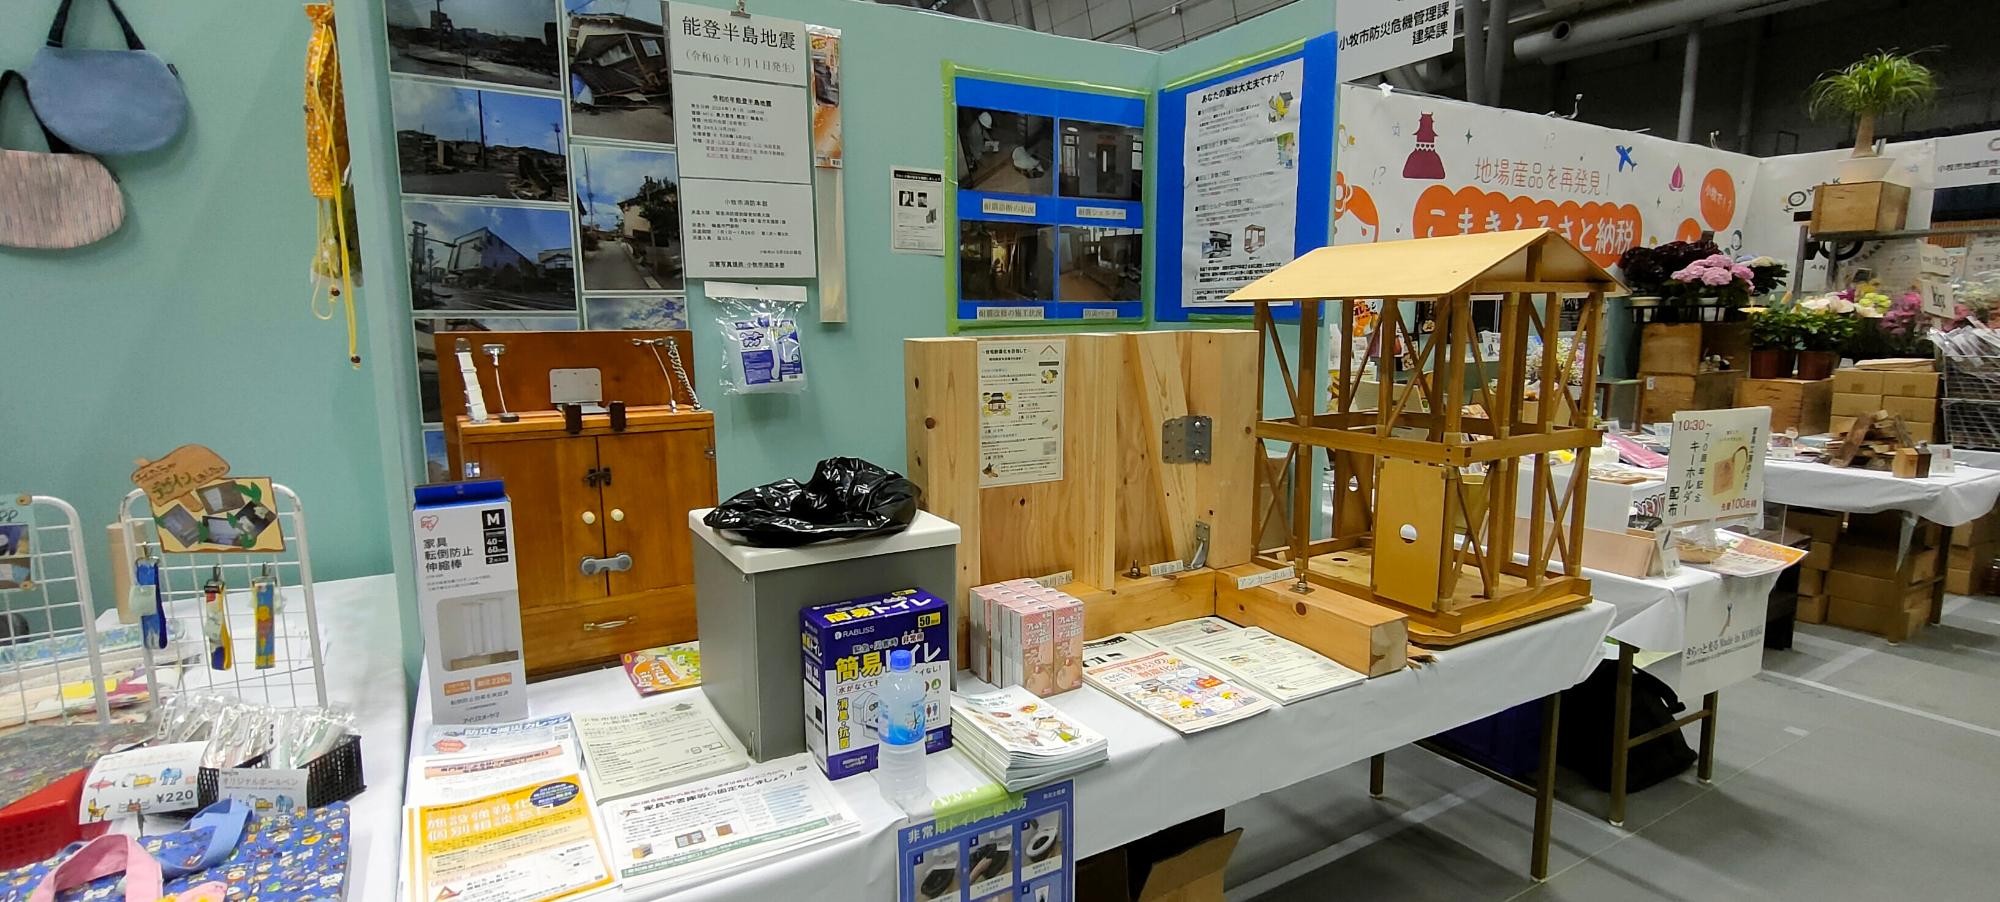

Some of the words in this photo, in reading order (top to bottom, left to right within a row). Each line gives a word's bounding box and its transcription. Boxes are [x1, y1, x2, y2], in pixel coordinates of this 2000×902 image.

[682, 16, 796, 51] 能登半島地震
[1339, 1, 1449, 50] 小牧市防災危機管理課
[1412, 21, 1448, 45] 建築課
[1683, 440, 1700, 516] キーホルダー
[1668, 486, 1680, 517] 配布
[486, 512, 500, 526] M
[423, 537, 447, 549] 家具
[424, 546, 474, 561] 転倒防止
[425, 559, 463, 573] 伸縮棒
[1239, 567, 1295, 587] アンカーボルト
[842, 626, 875, 637] RABLISS
[156, 789, 194, 803] ¥220
